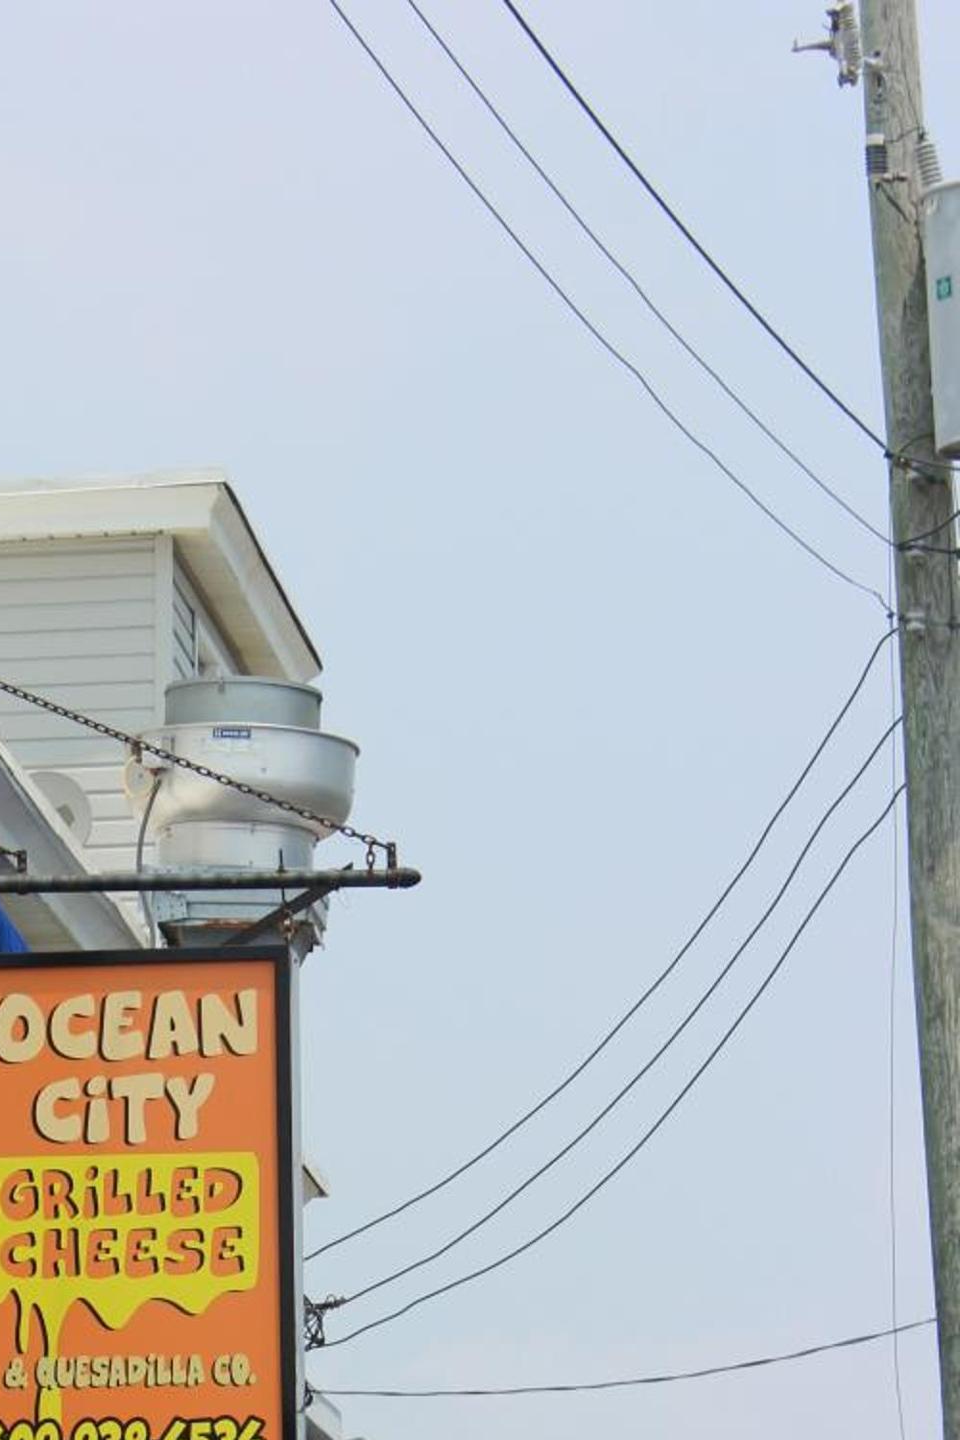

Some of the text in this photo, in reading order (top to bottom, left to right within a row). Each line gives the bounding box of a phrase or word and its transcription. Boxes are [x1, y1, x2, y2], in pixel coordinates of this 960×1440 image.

[0, 1225, 246, 1280] CHEESE
[2, 1356, 27, 1389] &
[212, 1353, 256, 1389] CO.
